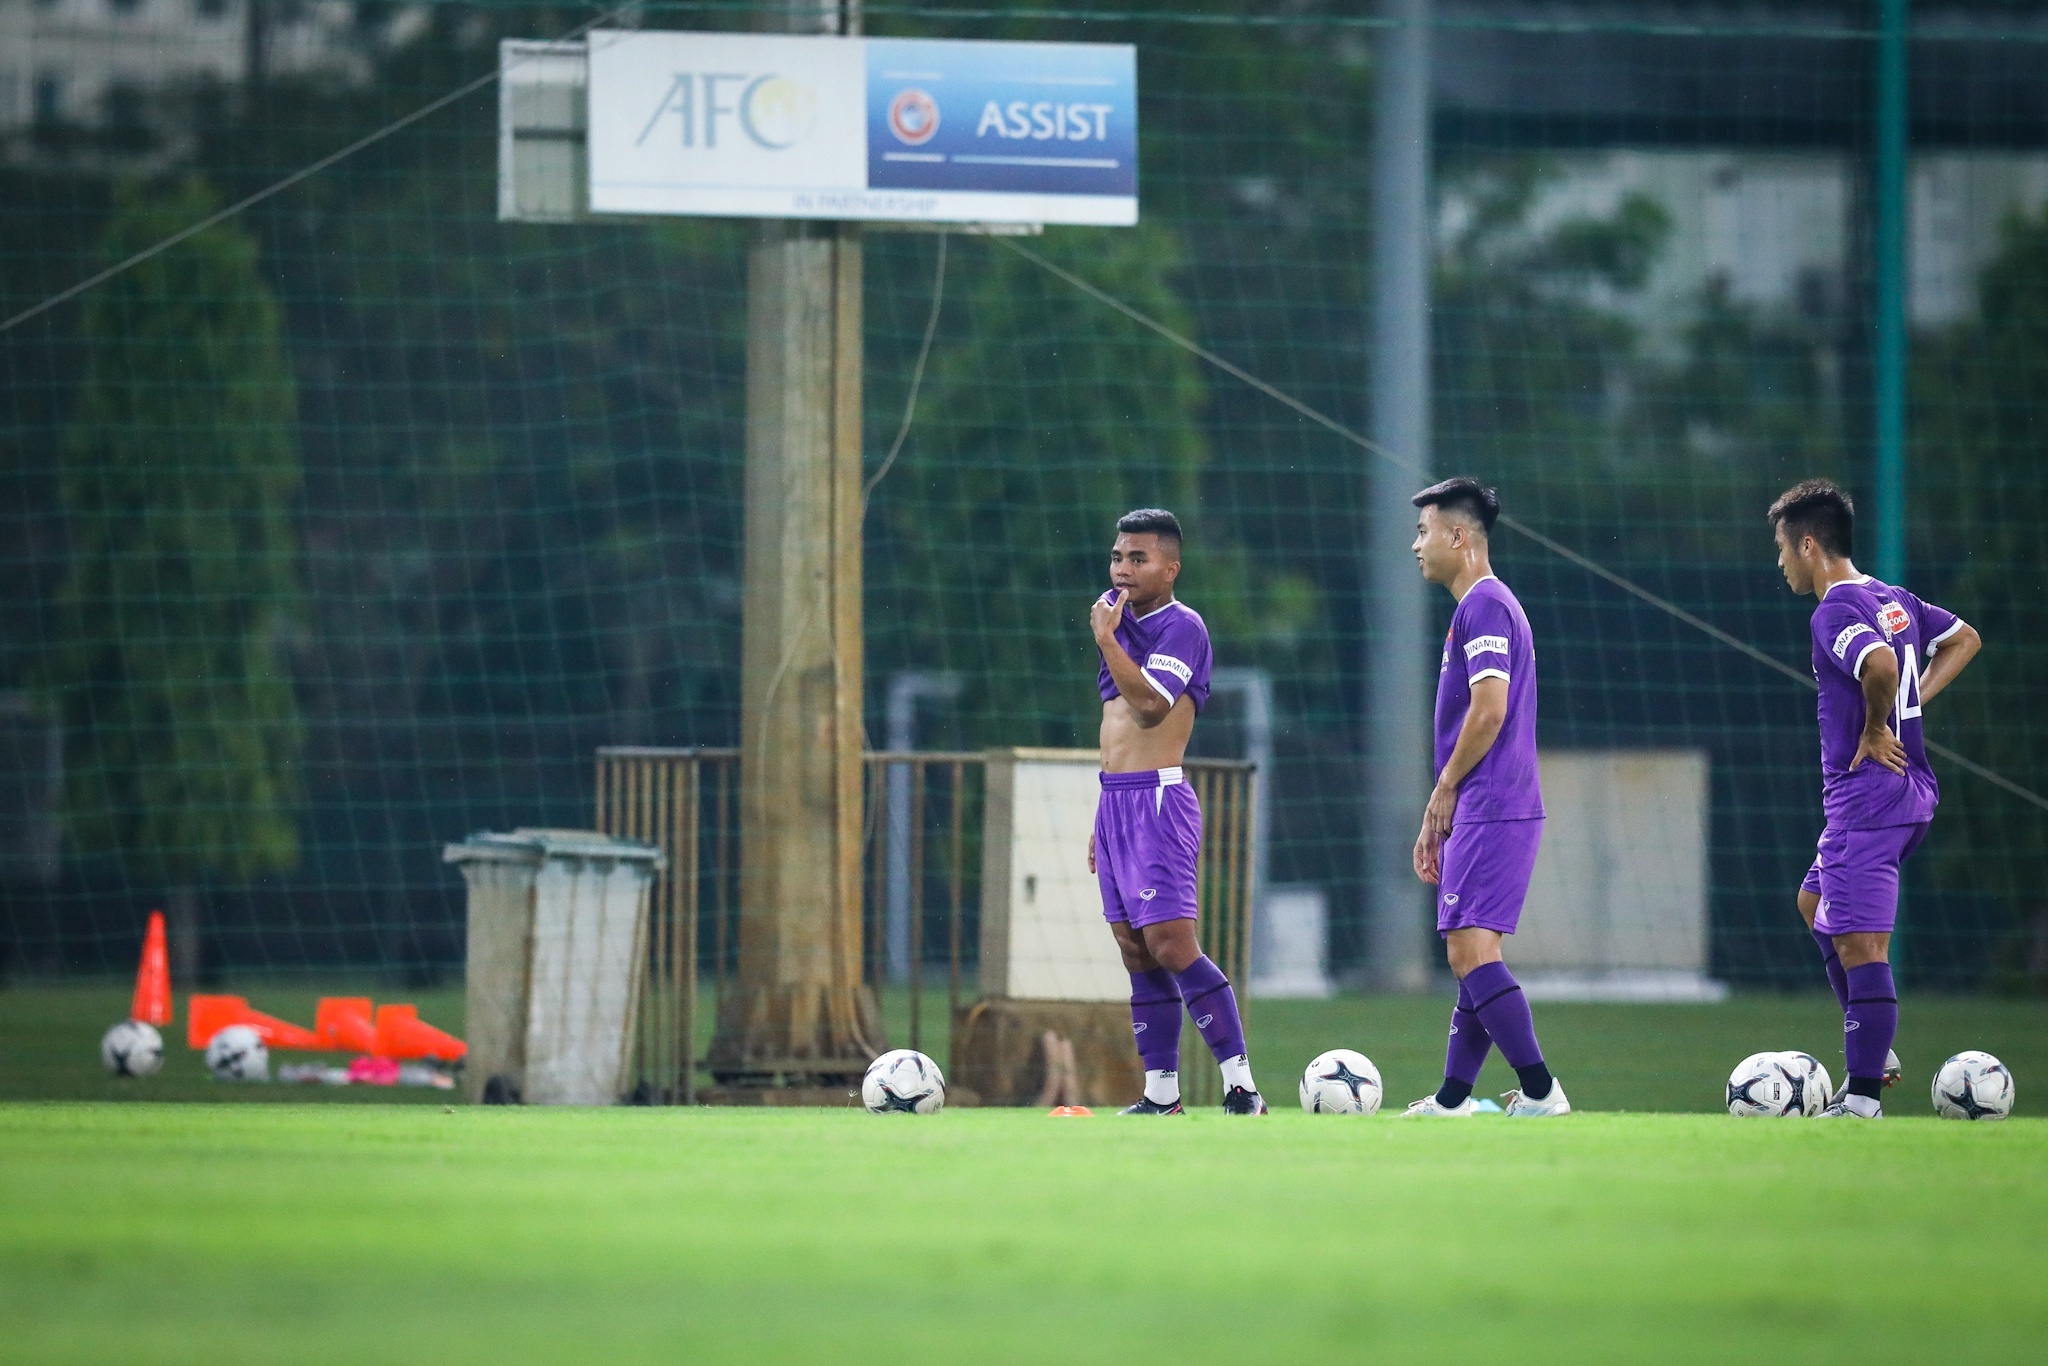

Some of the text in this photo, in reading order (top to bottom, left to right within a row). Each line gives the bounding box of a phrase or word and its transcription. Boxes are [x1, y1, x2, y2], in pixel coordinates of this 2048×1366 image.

[634, 72, 804, 151] AFC
[976, 101, 1114, 141] ASSIST
[1466, 639, 1507, 656] VINAMILK
[1835, 624, 1870, 654] VINAMIL
[1149, 657, 1191, 680] VINAMILK
